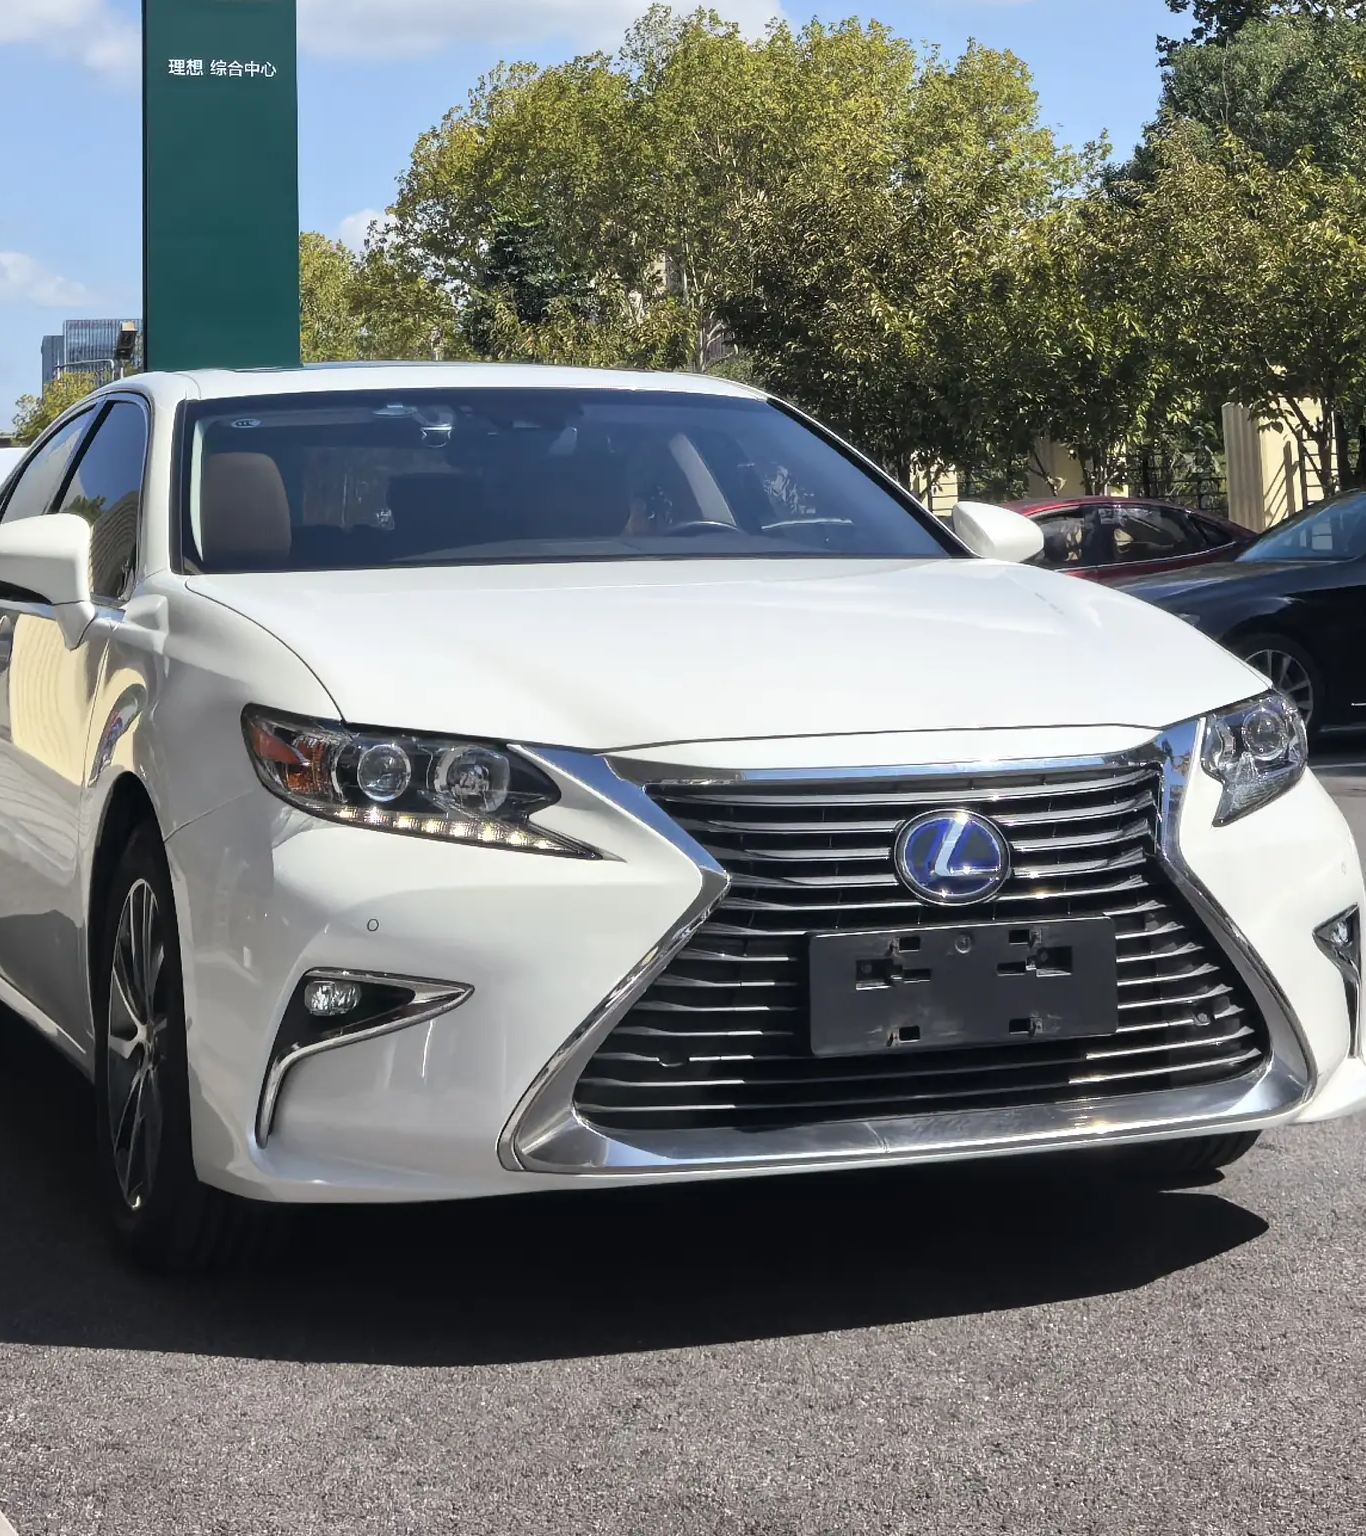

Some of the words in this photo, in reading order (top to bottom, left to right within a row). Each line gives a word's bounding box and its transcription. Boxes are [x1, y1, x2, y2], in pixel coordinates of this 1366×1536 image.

[168, 58, 203, 76] 理想
[210, 59, 277, 77] 综合中心
